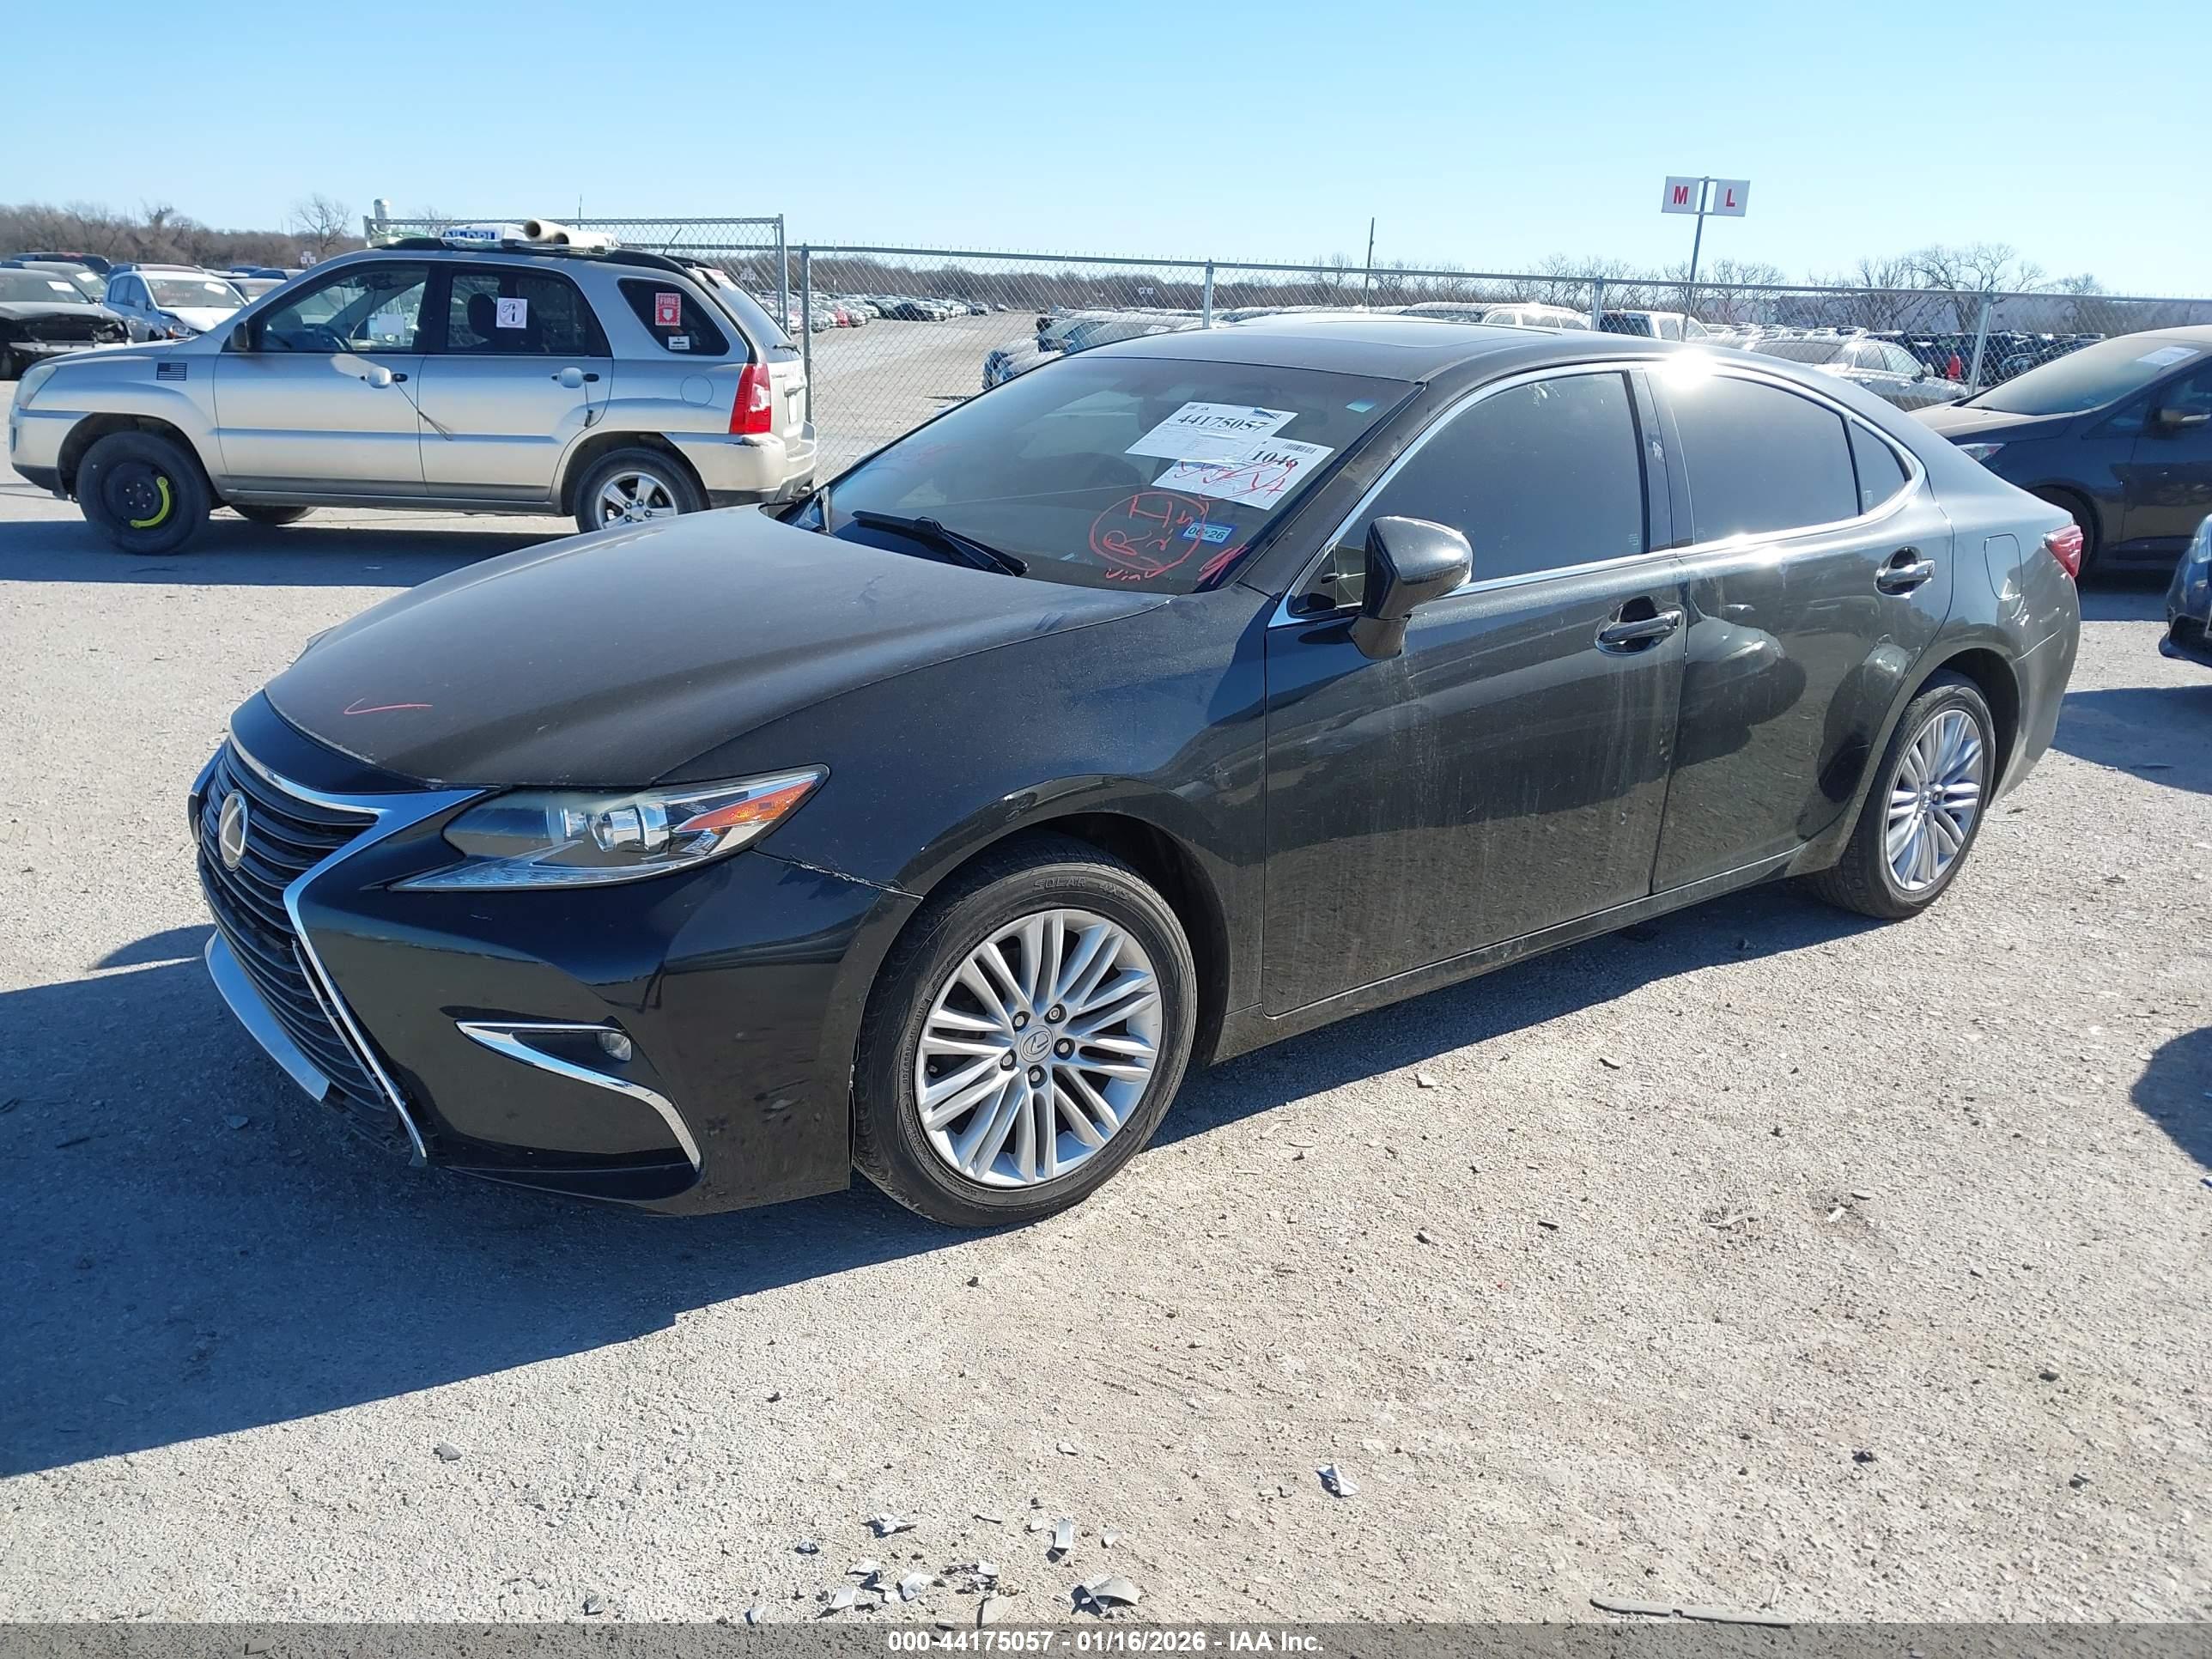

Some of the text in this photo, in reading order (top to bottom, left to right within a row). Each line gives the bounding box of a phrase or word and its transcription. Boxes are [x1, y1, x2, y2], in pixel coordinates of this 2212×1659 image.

[1674, 186, 1689, 204] M
[1726, 189, 1735, 207] L
[1177, 414, 1271, 432] 44175057
[1250, 450, 1306, 468] 1046
[1208, 530, 1224, 540] 26
[1034, 876, 1087, 889] SOLAR
